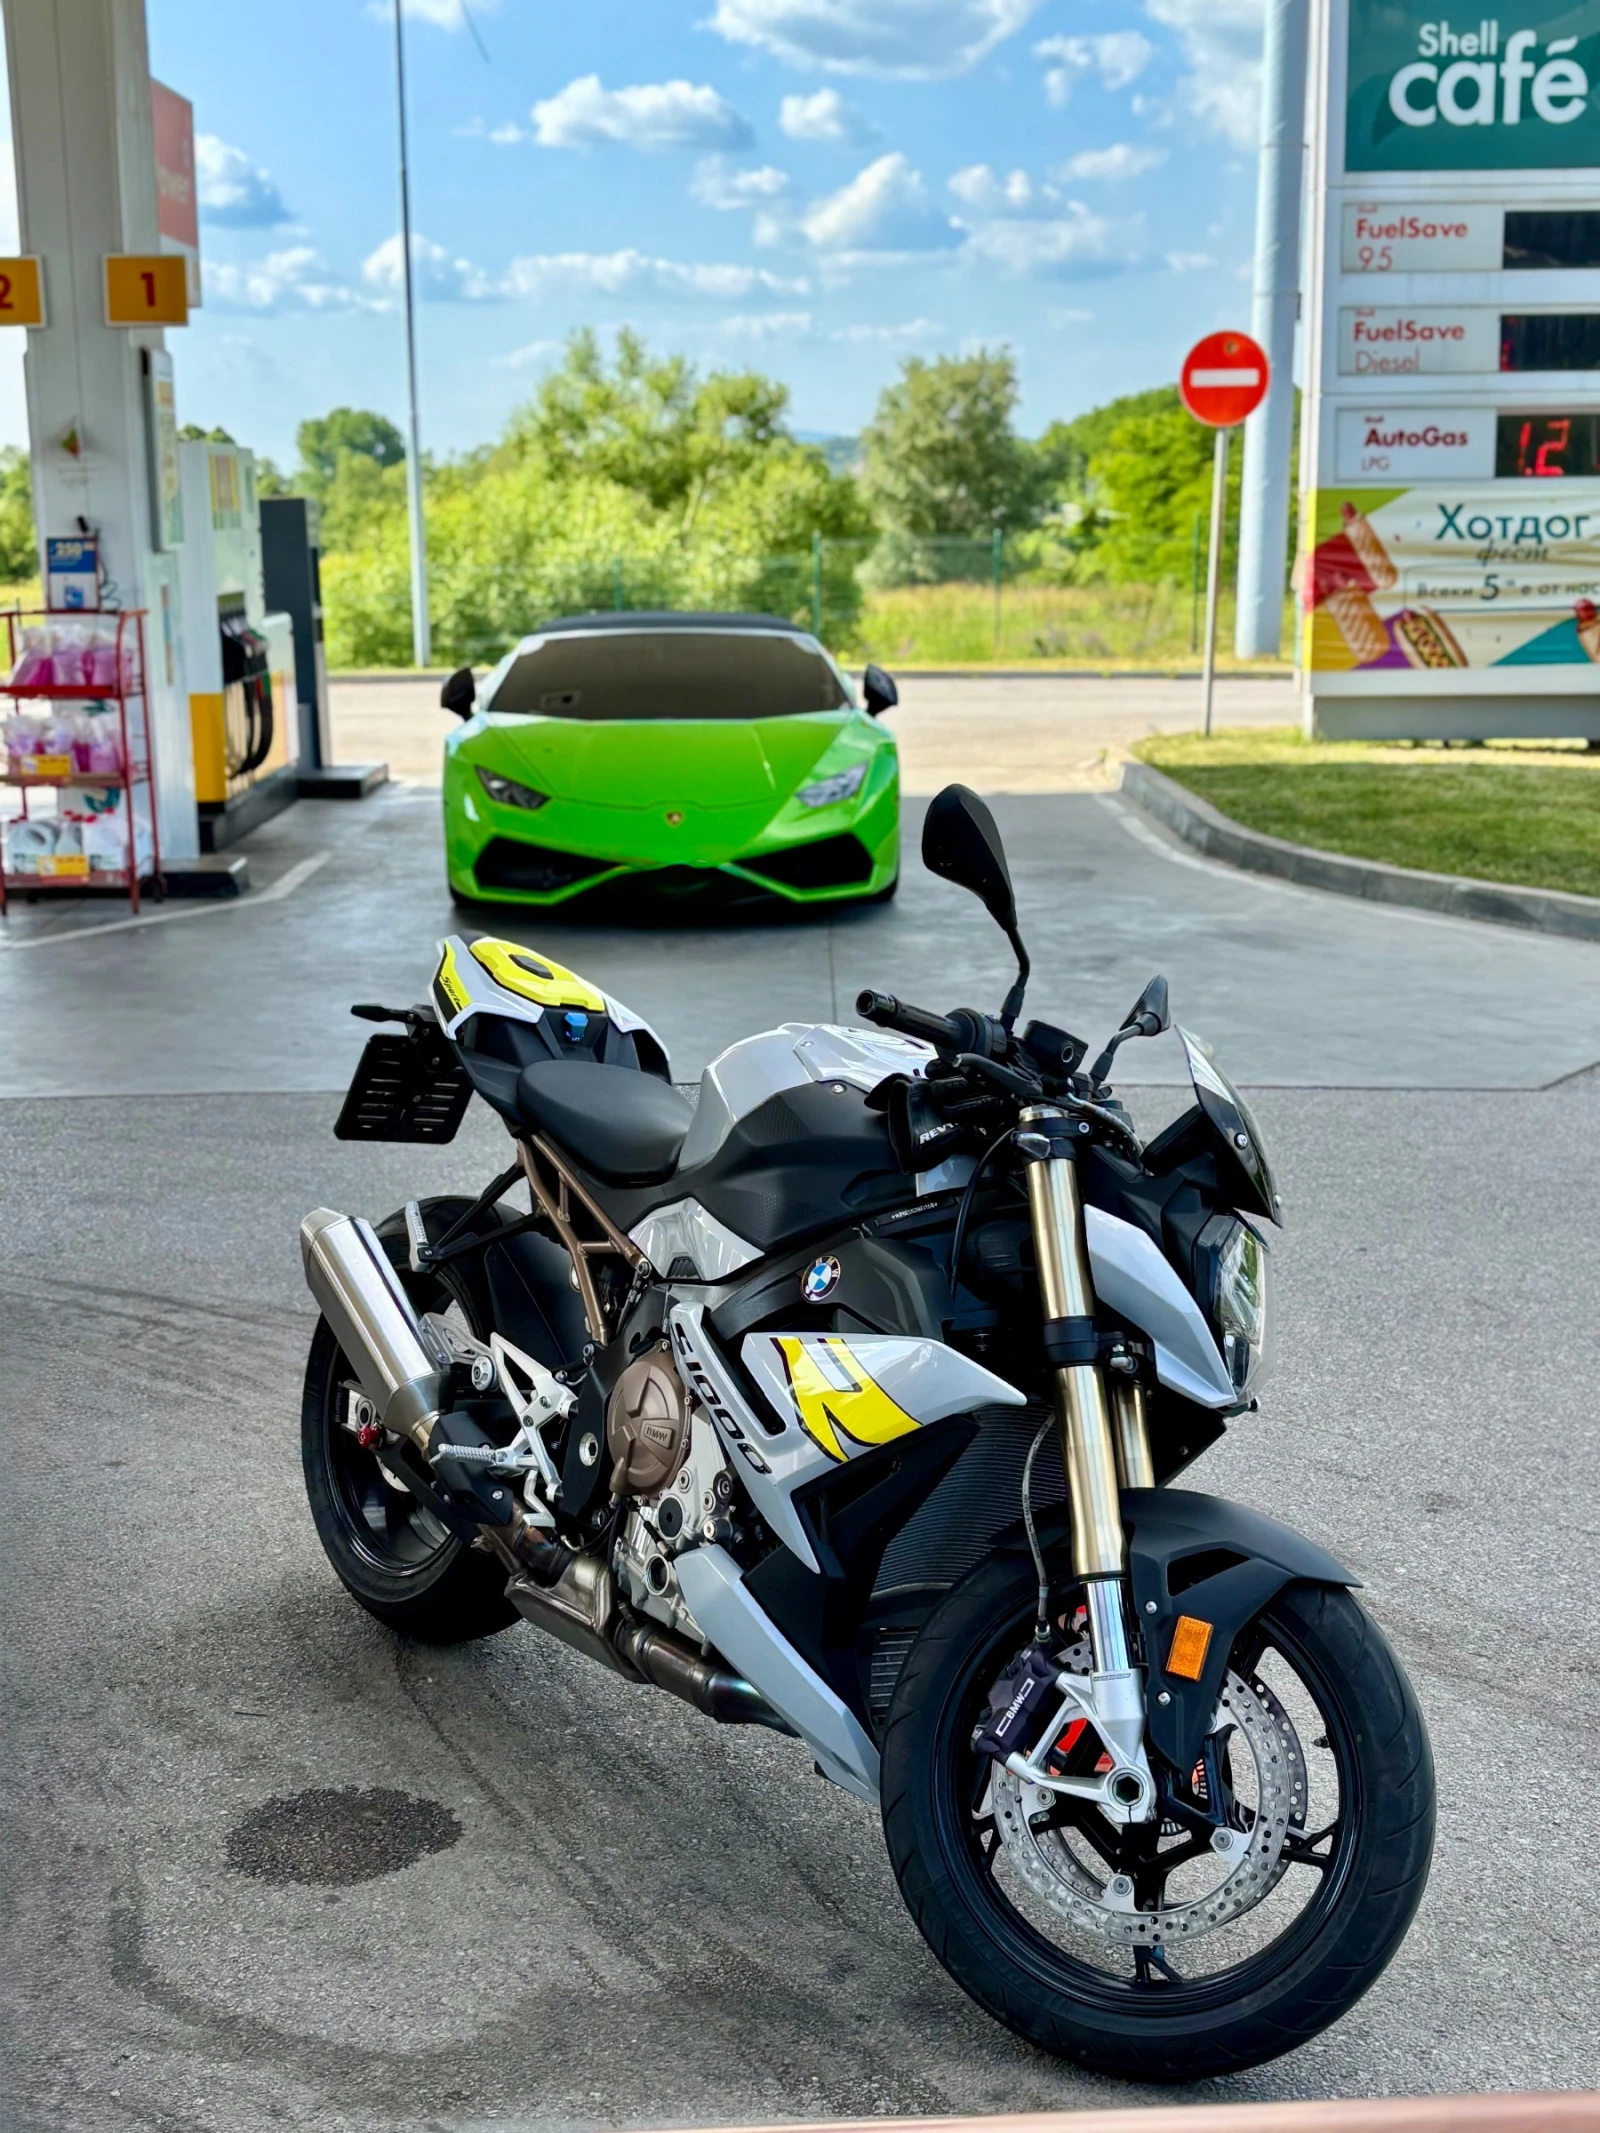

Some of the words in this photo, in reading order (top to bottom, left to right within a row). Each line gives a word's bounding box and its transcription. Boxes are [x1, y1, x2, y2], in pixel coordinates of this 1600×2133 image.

[1418, 20, 1498, 56] Shell
[1388, 29, 1588, 126] café
[1355, 216, 1468, 239] FuelSave
[1358, 246, 1393, 272] 95
[140, 272, 156, 307] 1
[1353, 320, 1465, 342] FuelSave
[1355, 347, 1420, 373] Diesel
[1364, 427, 1468, 447] AutoGas
[1361, 456, 1390, 472] LPG
[1434, 503, 1590, 545] Хотдог
[646, 1426, 668, 1442] BMW
[1005, 1692, 1025, 1720] BMW
